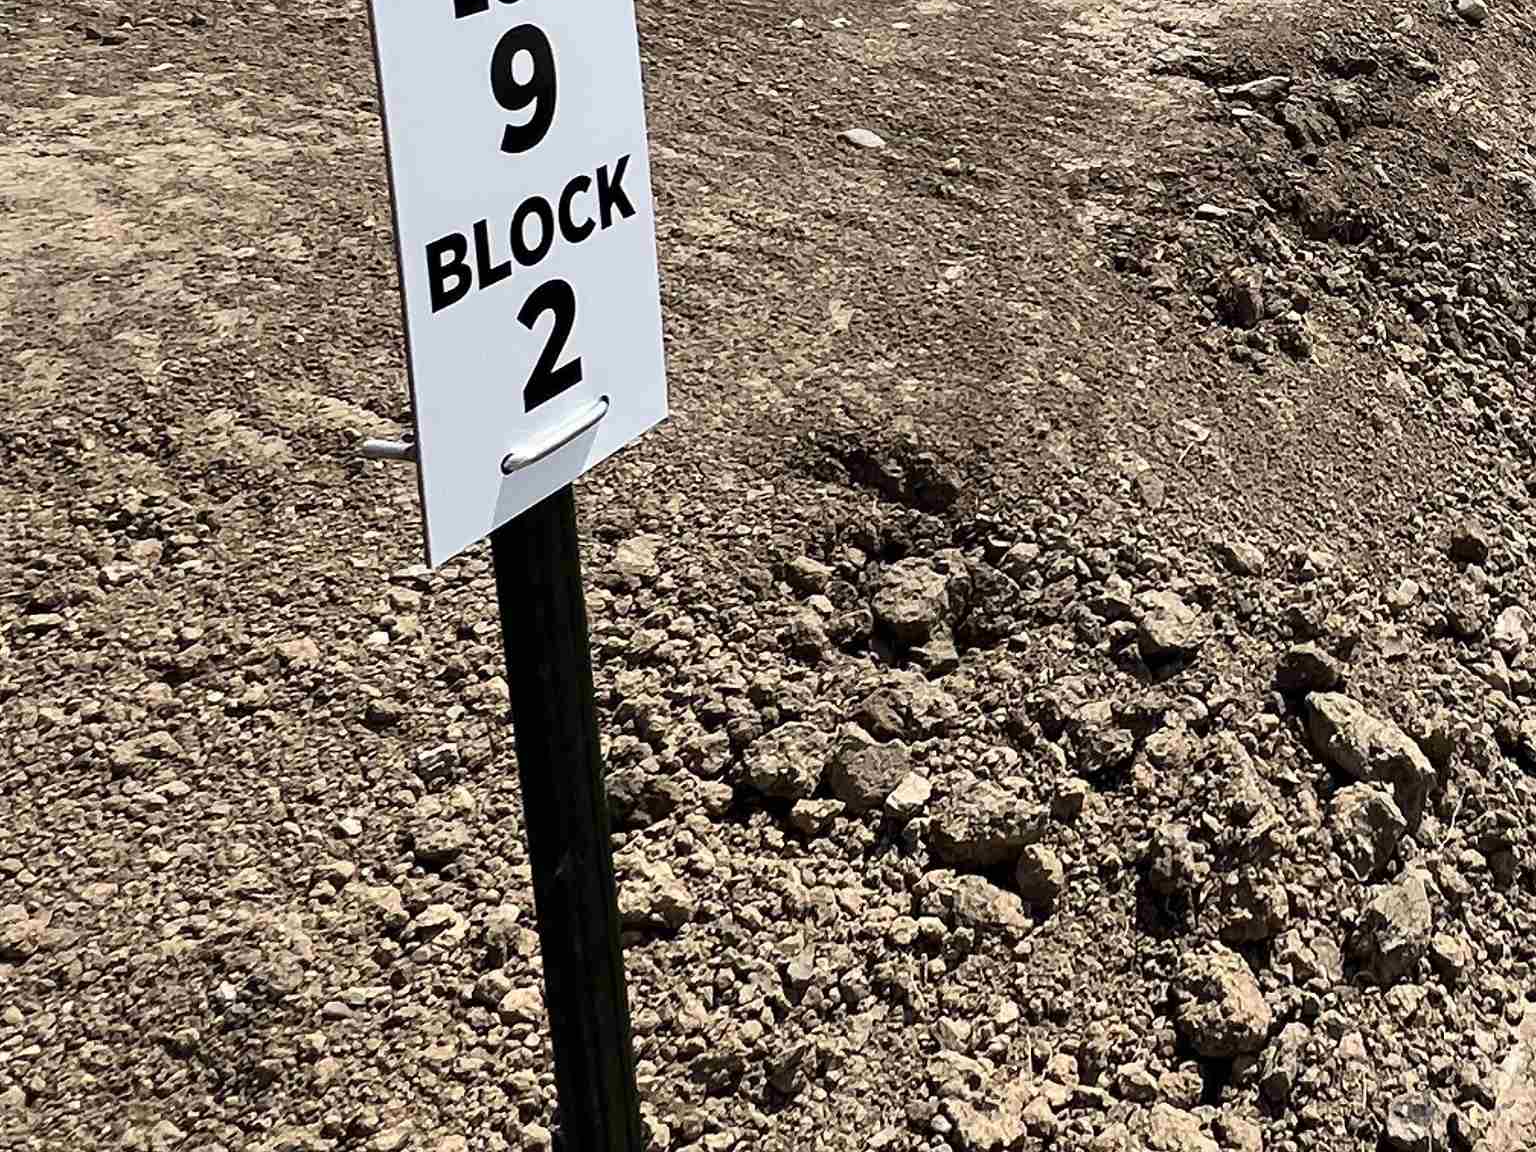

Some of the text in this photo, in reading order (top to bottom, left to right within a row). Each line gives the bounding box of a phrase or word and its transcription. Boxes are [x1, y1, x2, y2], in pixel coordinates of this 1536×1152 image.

[490, 23, 557, 154] 9
[425, 154, 636, 314] BLOCK
[516, 279, 583, 414] 2
